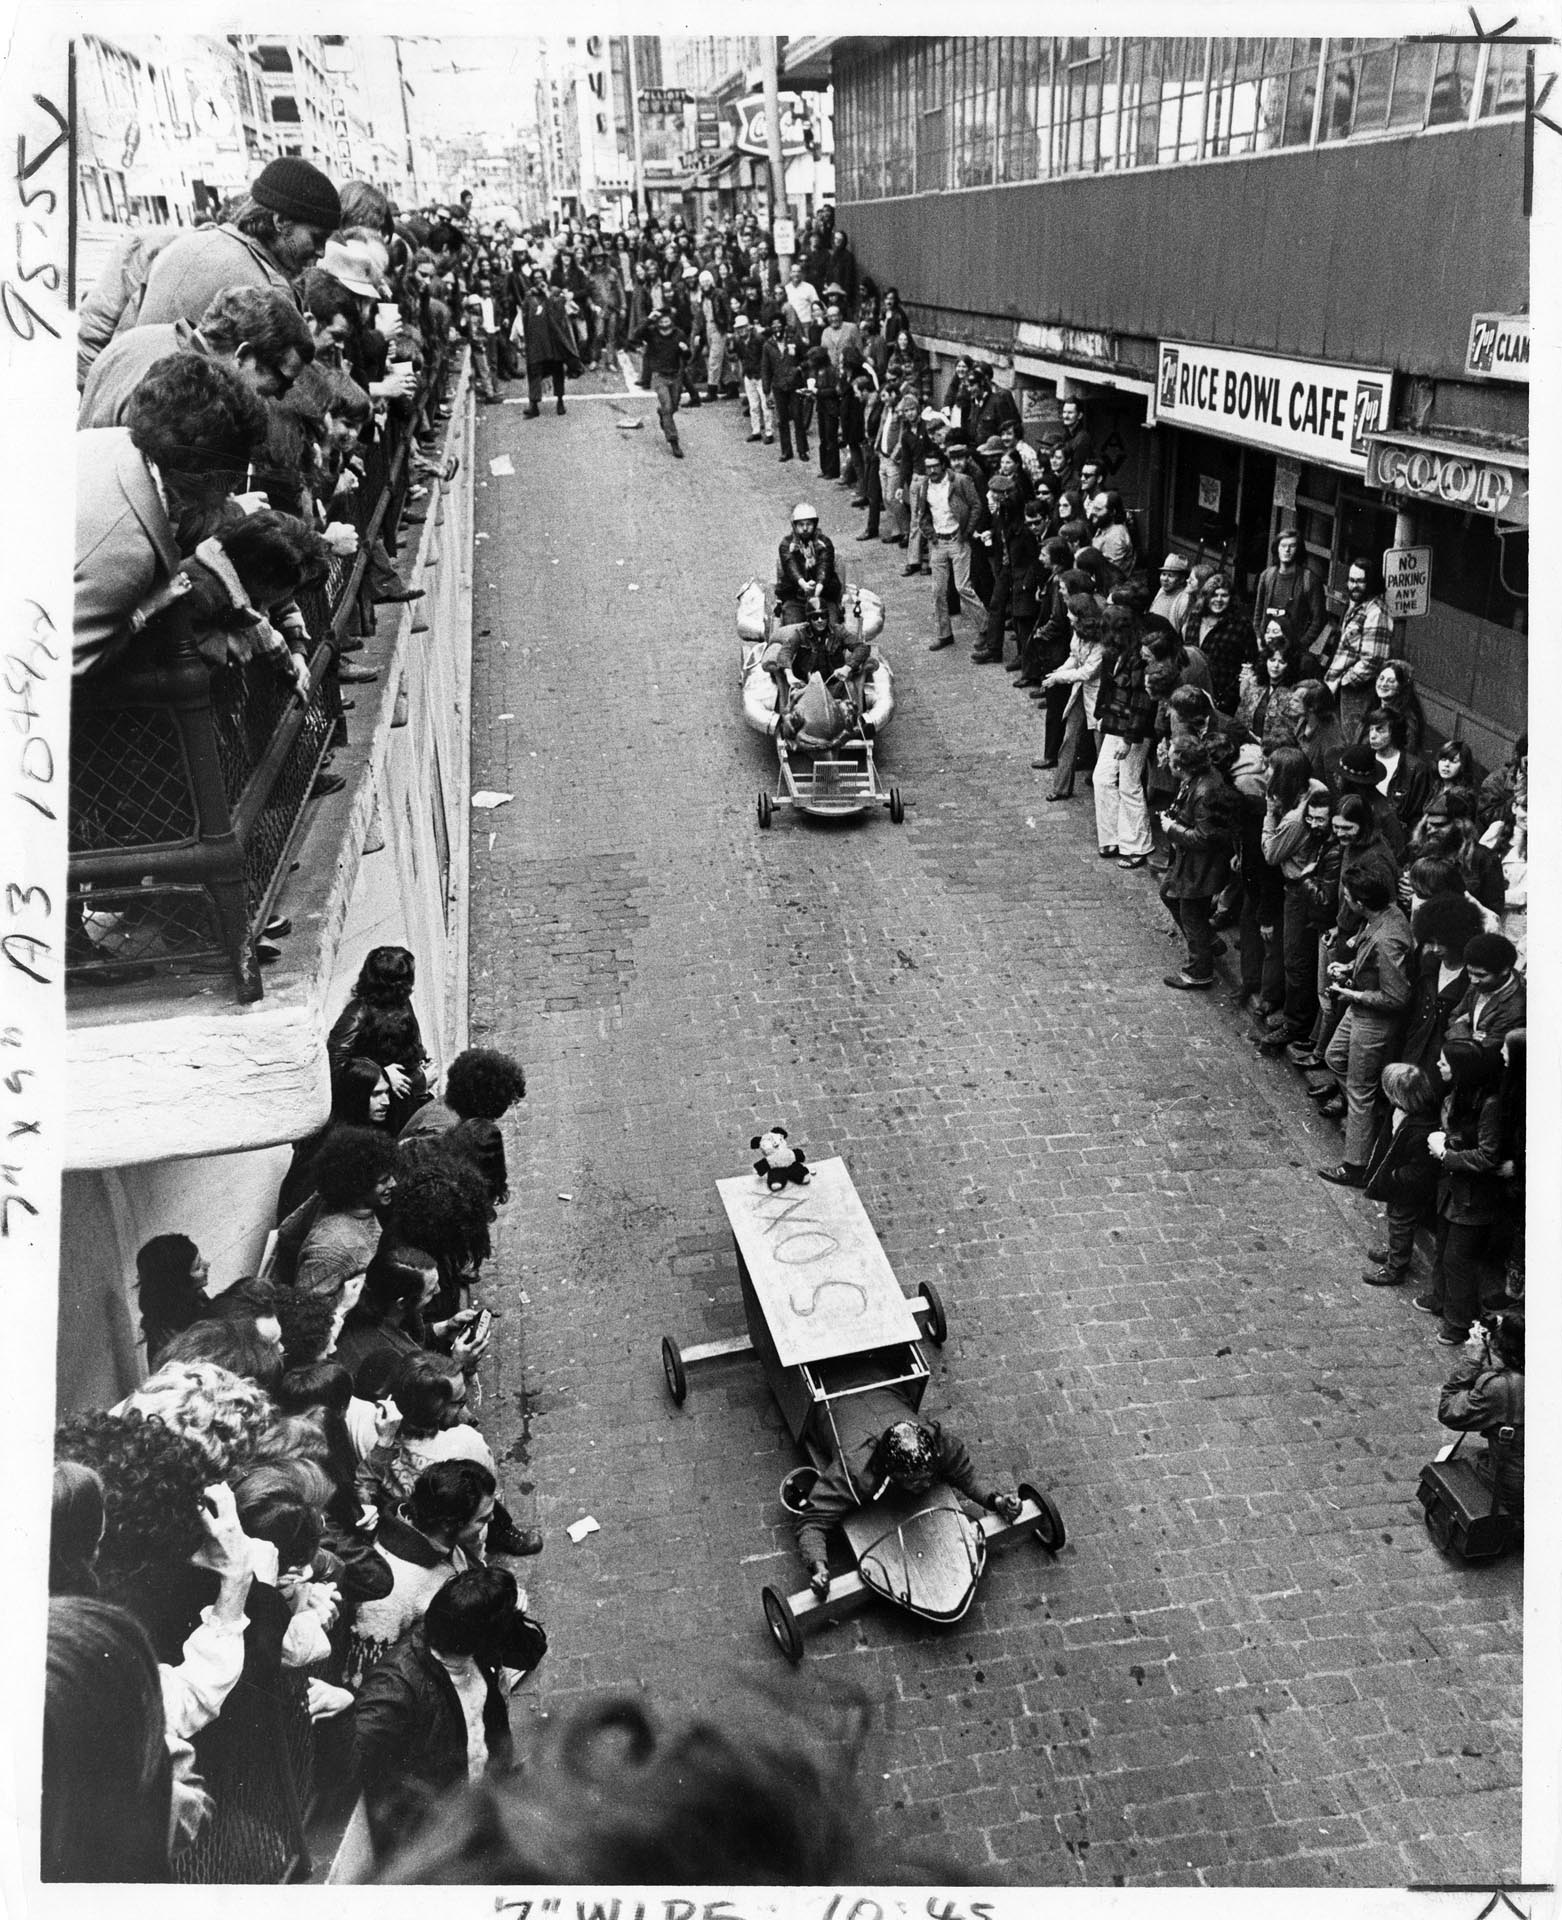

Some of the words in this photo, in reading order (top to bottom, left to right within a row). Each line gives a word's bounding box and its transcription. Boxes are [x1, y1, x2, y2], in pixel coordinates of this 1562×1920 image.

[551, 80, 564, 160] KRESS
[1179, 362, 1219, 412] RICE
[1223, 370, 1282, 427] BOWL
[1288, 381, 1348, 441] CAFE
[1377, 446, 1513, 512] GOOD
[1397, 556, 1417, 570] NO
[1387, 573, 1427, 587] PARKING
[1395, 588, 1416, 599] ANY
[1394, 601, 1418, 611] TIME
